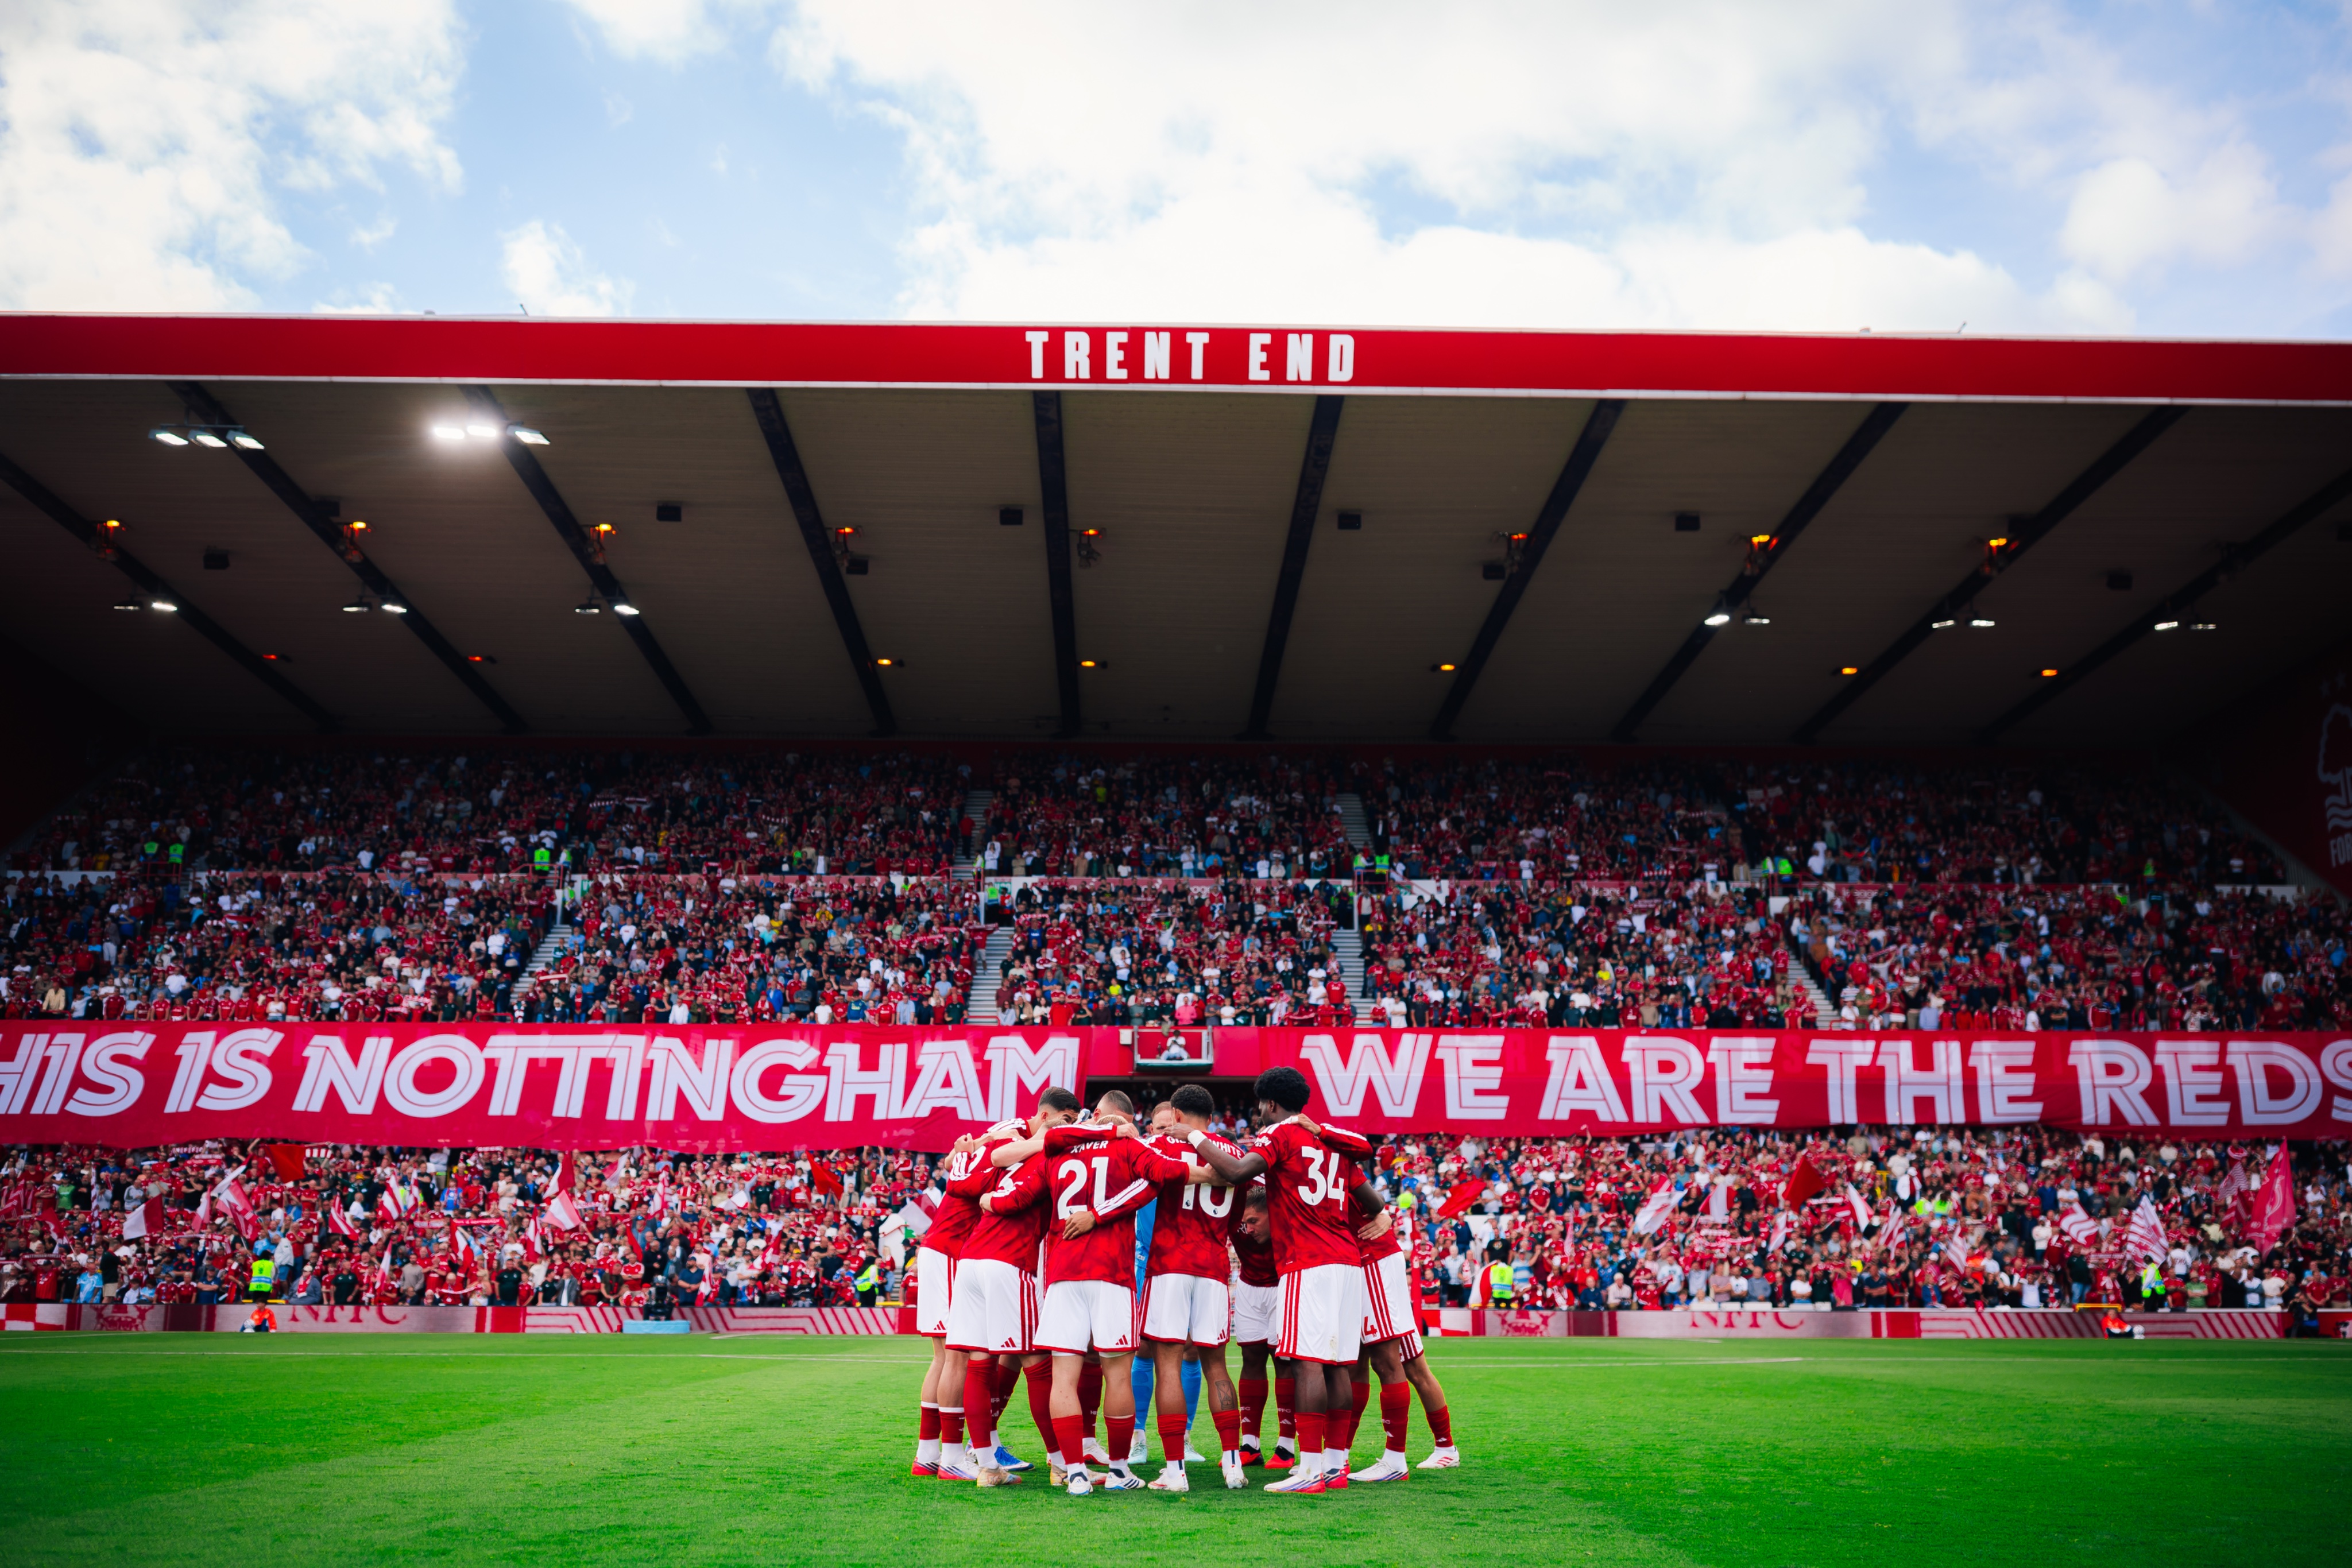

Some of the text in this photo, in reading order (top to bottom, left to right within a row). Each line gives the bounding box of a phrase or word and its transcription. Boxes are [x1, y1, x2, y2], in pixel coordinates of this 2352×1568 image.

[1025, 331, 1355, 382] TRENT END
[2330, 833, 2352, 868] FOR
[0, 1027, 1080, 1124] HIS IS NOTTINGHAM
[1300, 1033, 1510, 1120] WE
[1538, 1035, 1780, 1124] ARE
[1805, 1039, 2044, 1125] THE
[1070, 1140, 1109, 1153] XAVER
[1057, 1156, 1109, 1220] 21
[1298, 1146, 1345, 1211] 34
[1361, 1316, 1378, 1341] 4
